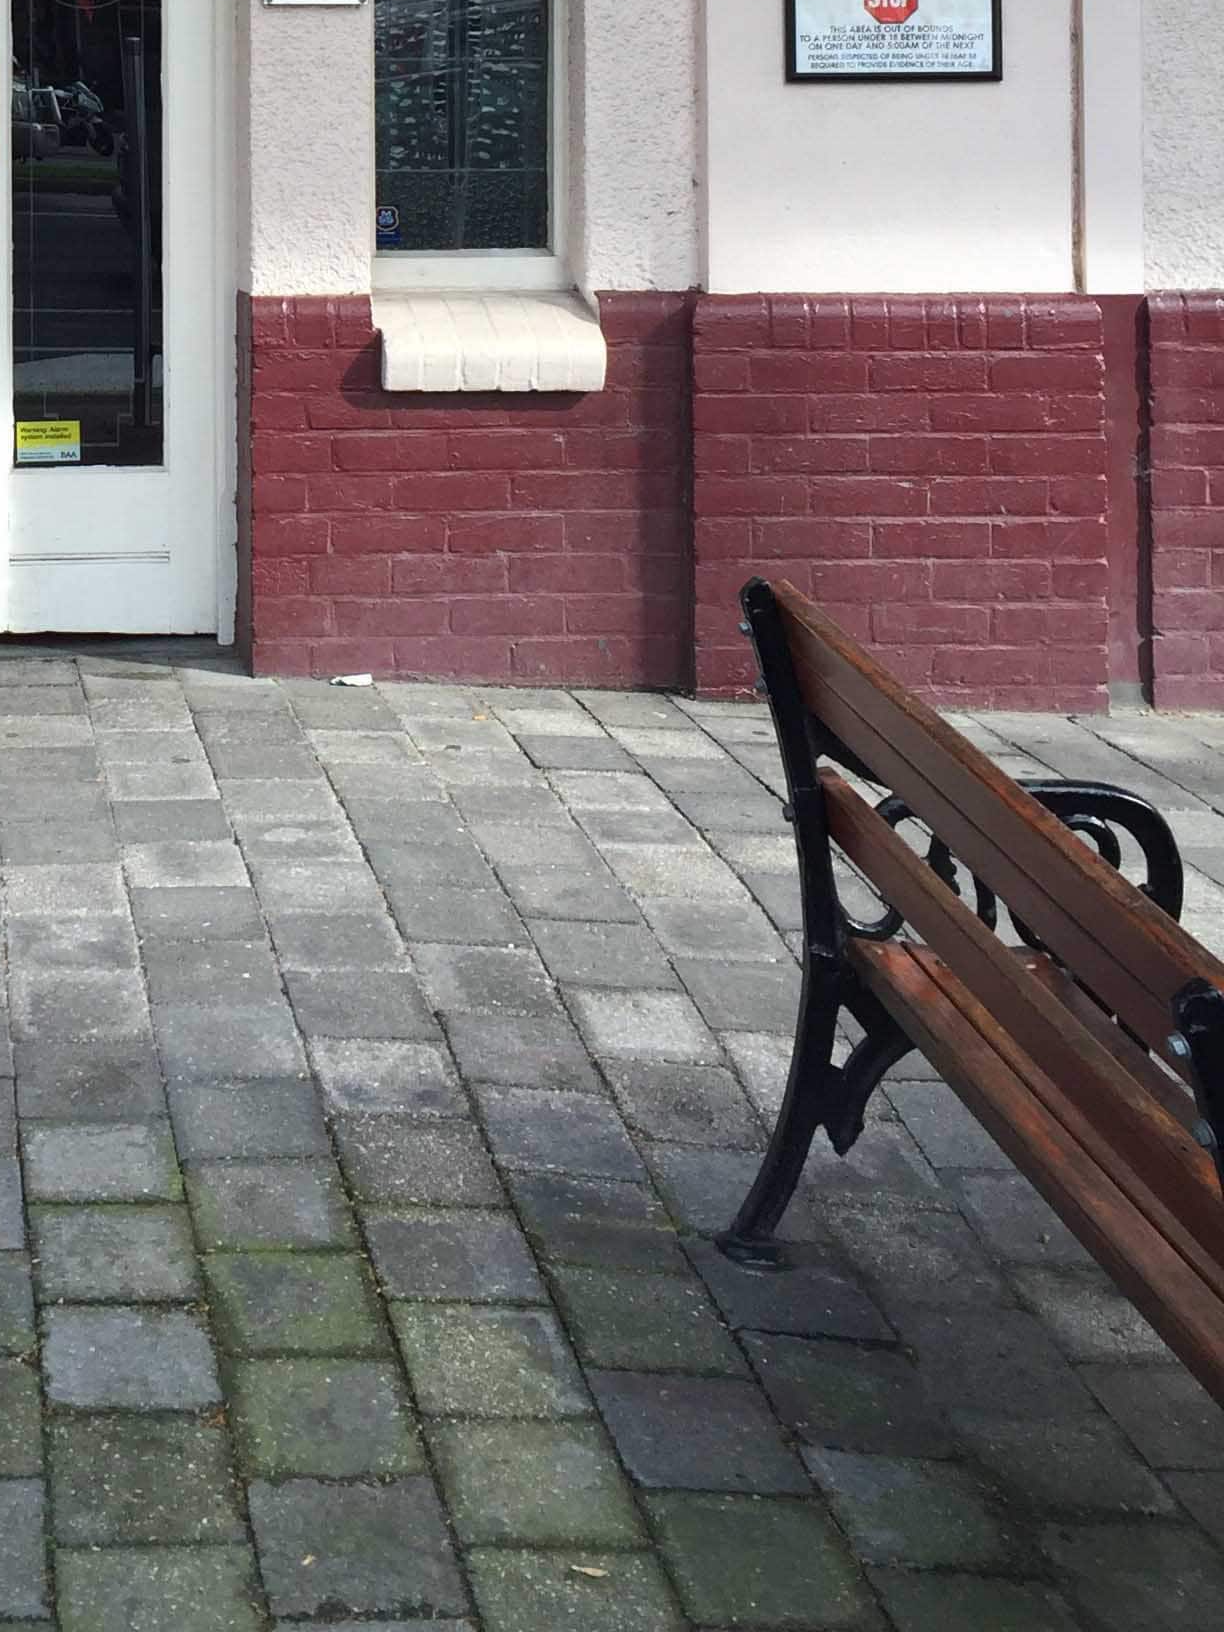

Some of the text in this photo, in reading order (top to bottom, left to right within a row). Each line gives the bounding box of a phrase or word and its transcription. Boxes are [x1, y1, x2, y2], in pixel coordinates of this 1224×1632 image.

[850, 25, 871, 33] AREA
[884, 24, 901, 32] OUT
[903, 24, 914, 32] OF
[808, 42, 823, 50] ON
[825, 42, 842, 50] ONE
[846, 42, 862, 50] DAY
[866, 42, 884, 50] AND
[922, 41, 932, 49] OF
